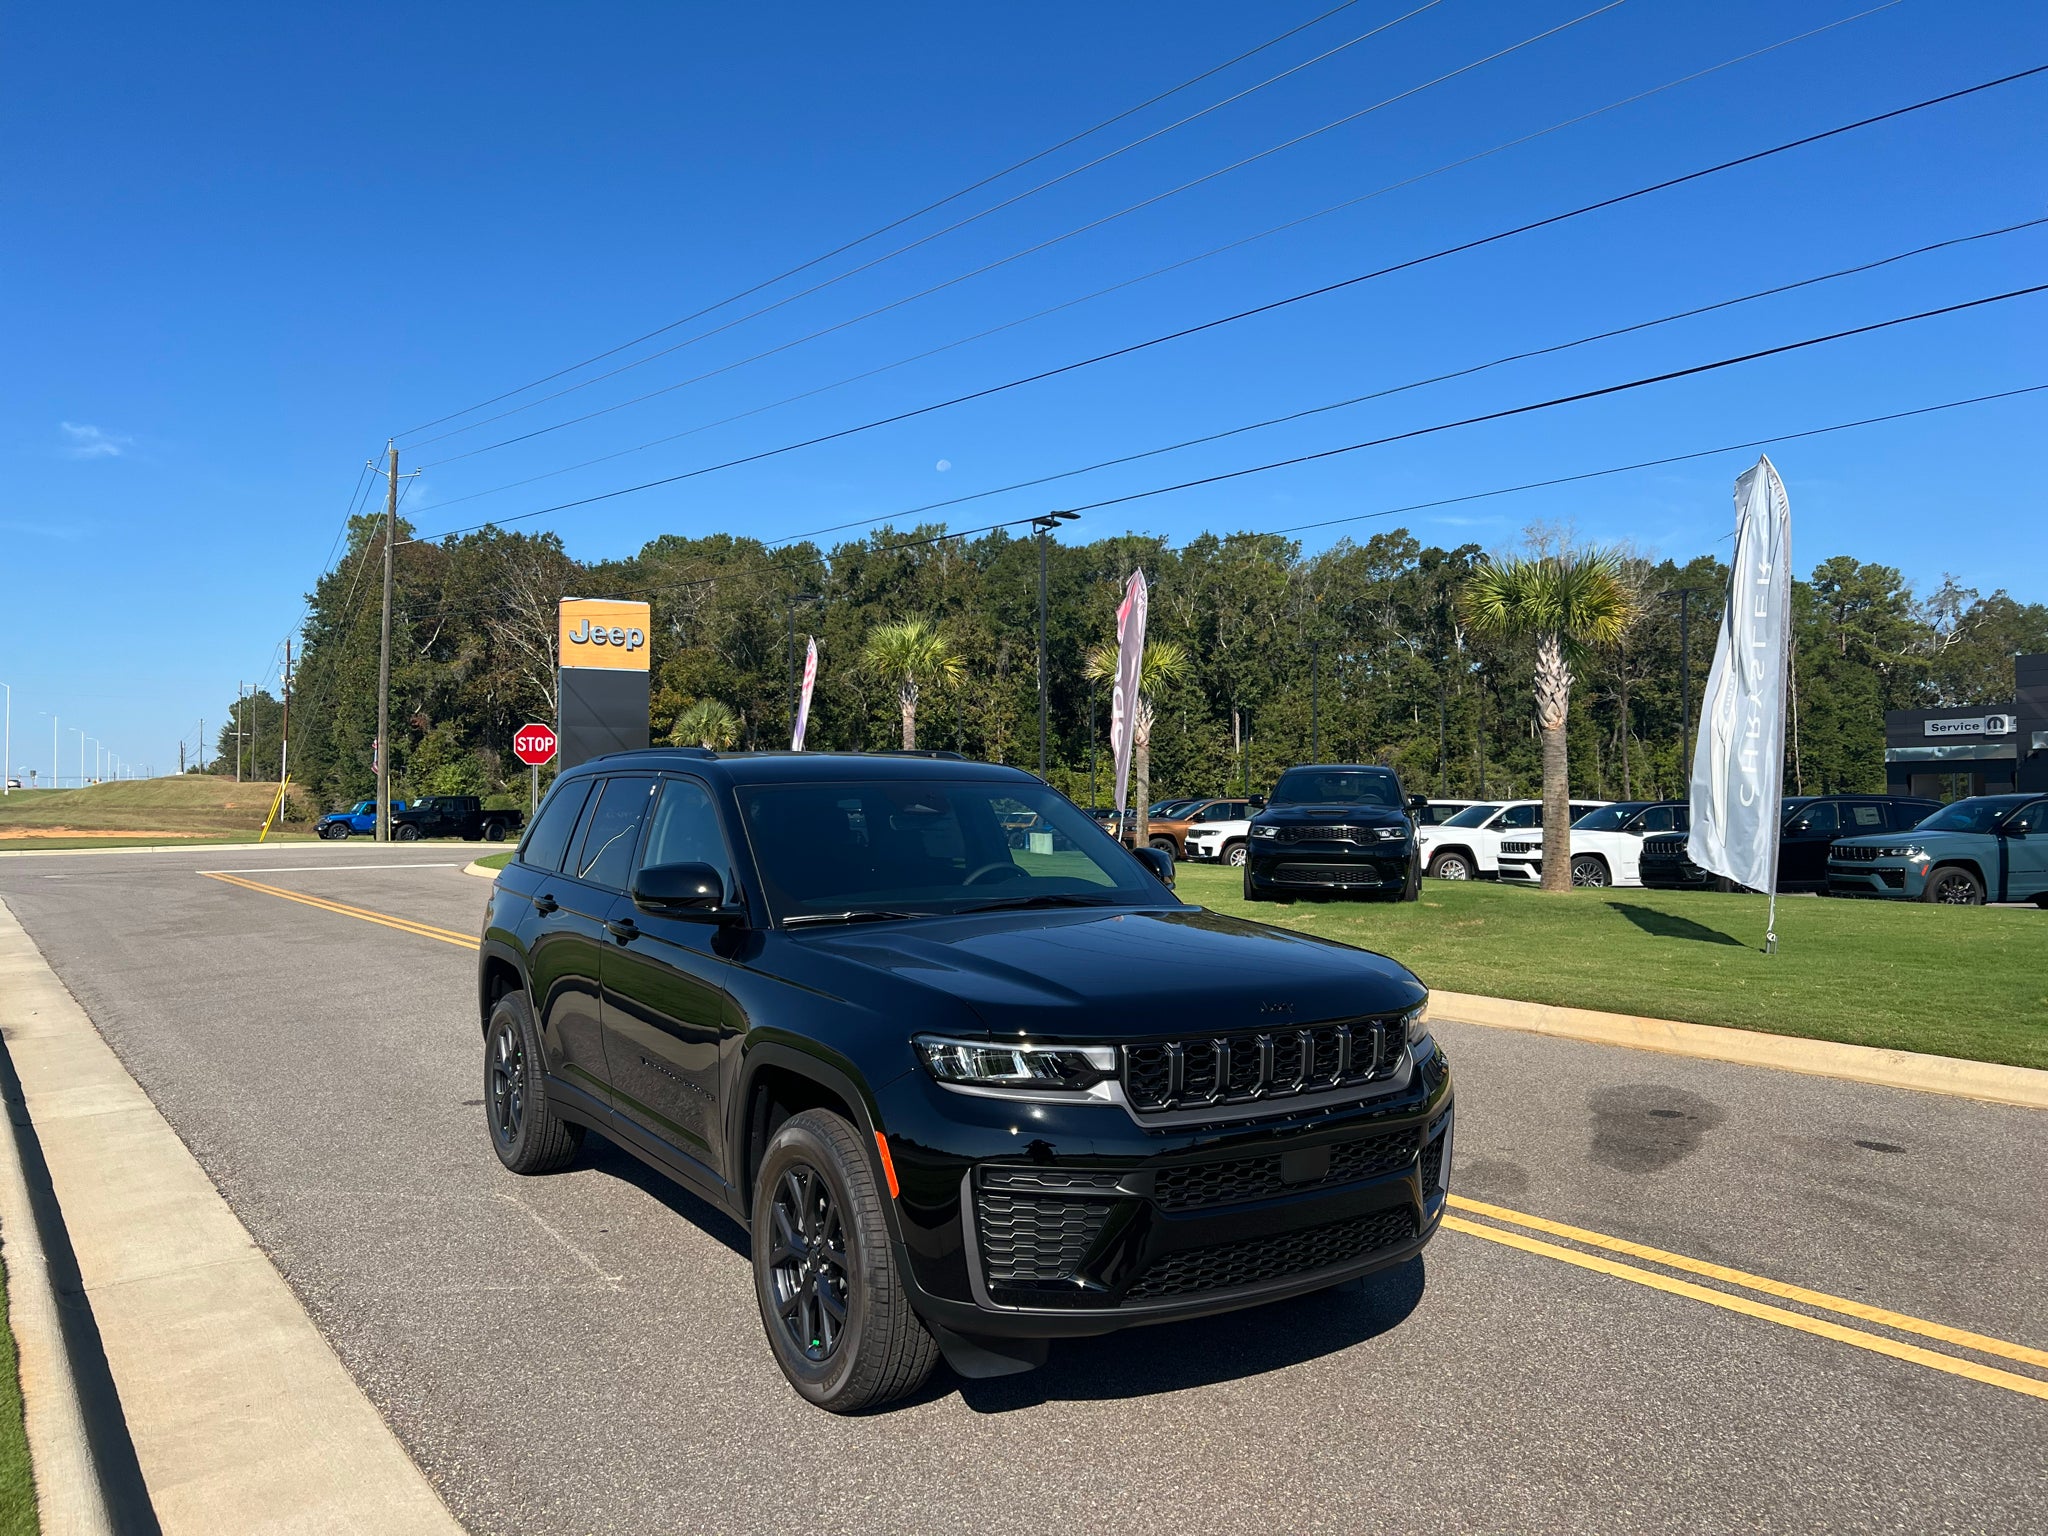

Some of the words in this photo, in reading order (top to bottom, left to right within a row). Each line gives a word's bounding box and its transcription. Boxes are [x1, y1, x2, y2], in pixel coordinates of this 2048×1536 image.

[569, 619, 644, 651] Jeep
[1931, 722, 1980, 732] Service
[517, 737, 554, 752] STOP
